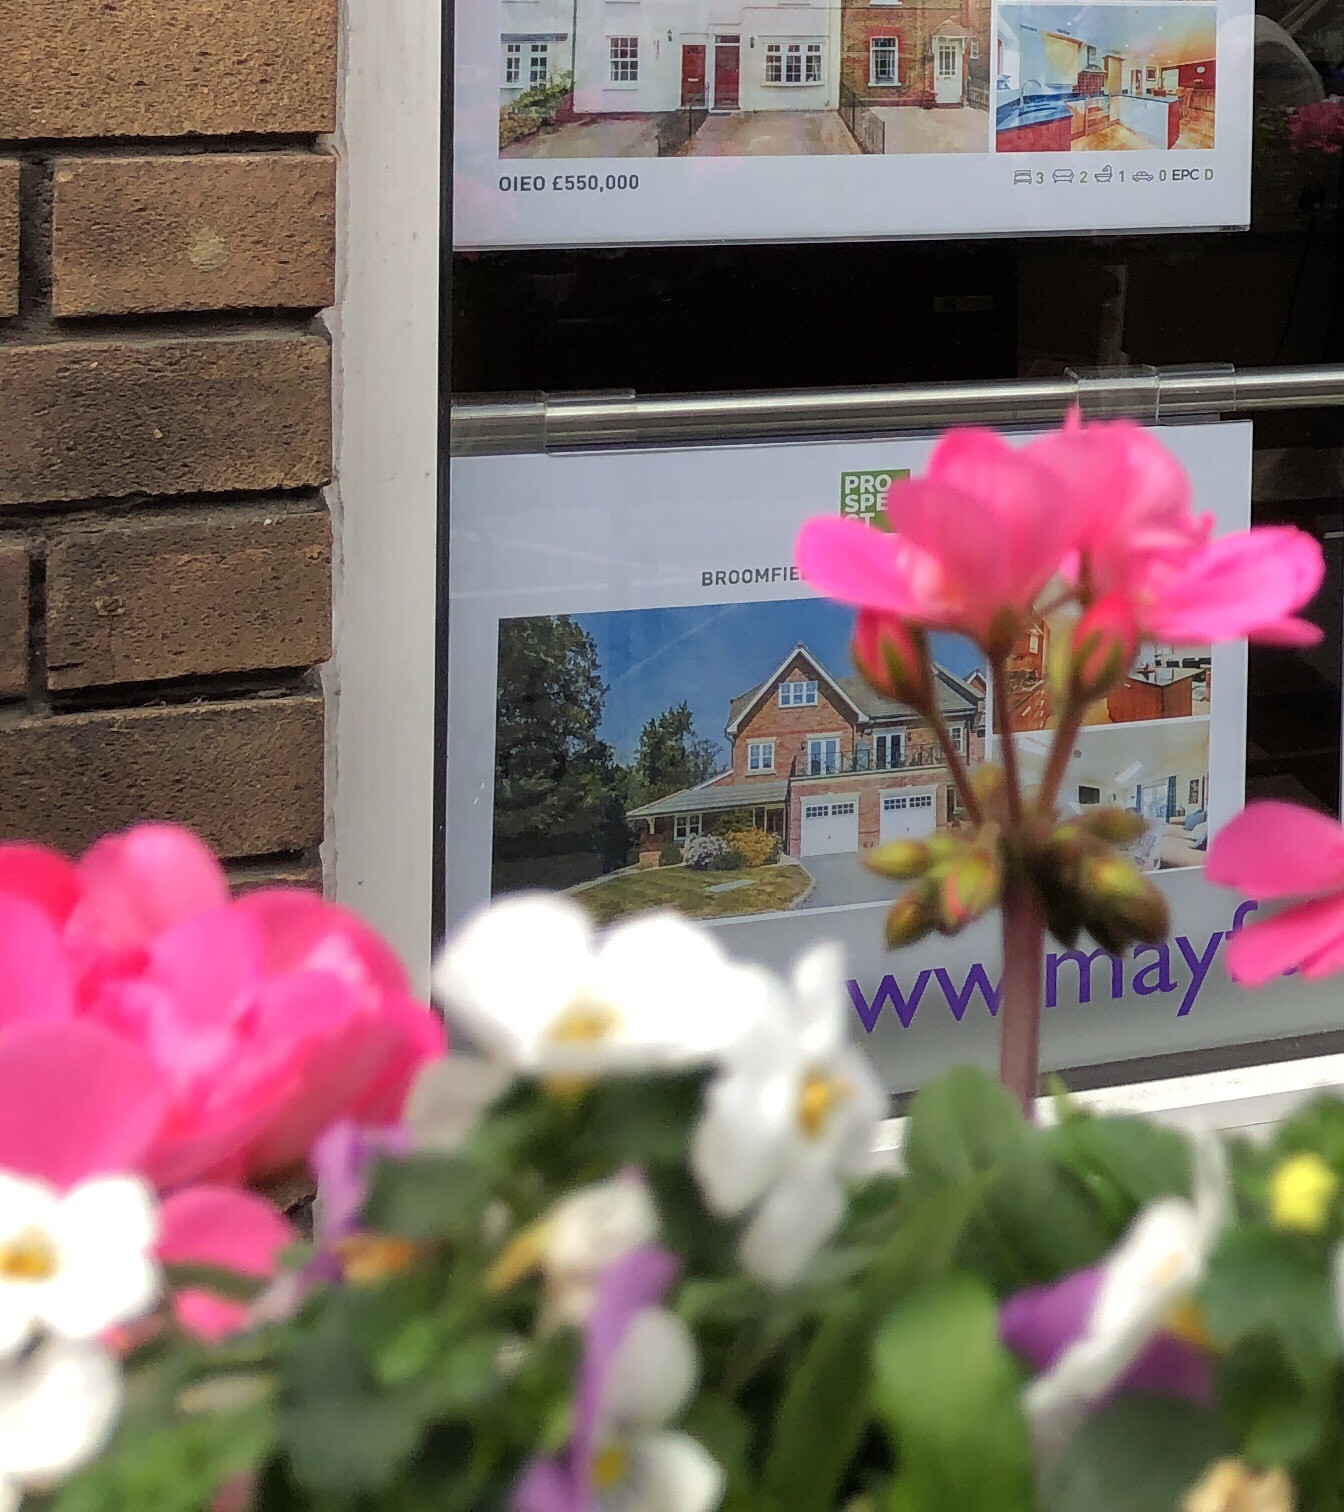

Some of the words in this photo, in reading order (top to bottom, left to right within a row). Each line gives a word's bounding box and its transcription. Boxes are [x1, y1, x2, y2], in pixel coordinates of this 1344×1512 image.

[499, 176, 545, 191] OIEO
[552, 174, 639, 193] £550,000
[1036, 172, 1044, 184] 3
[1080, 171, 1088, 183] 2
[1118, 171, 1125, 182] 1
[1172, 169, 1200, 181] EPC
[1205, 169, 1214, 180] D
[845, 474, 892, 494] PRO
[845, 493, 888, 512] SPE
